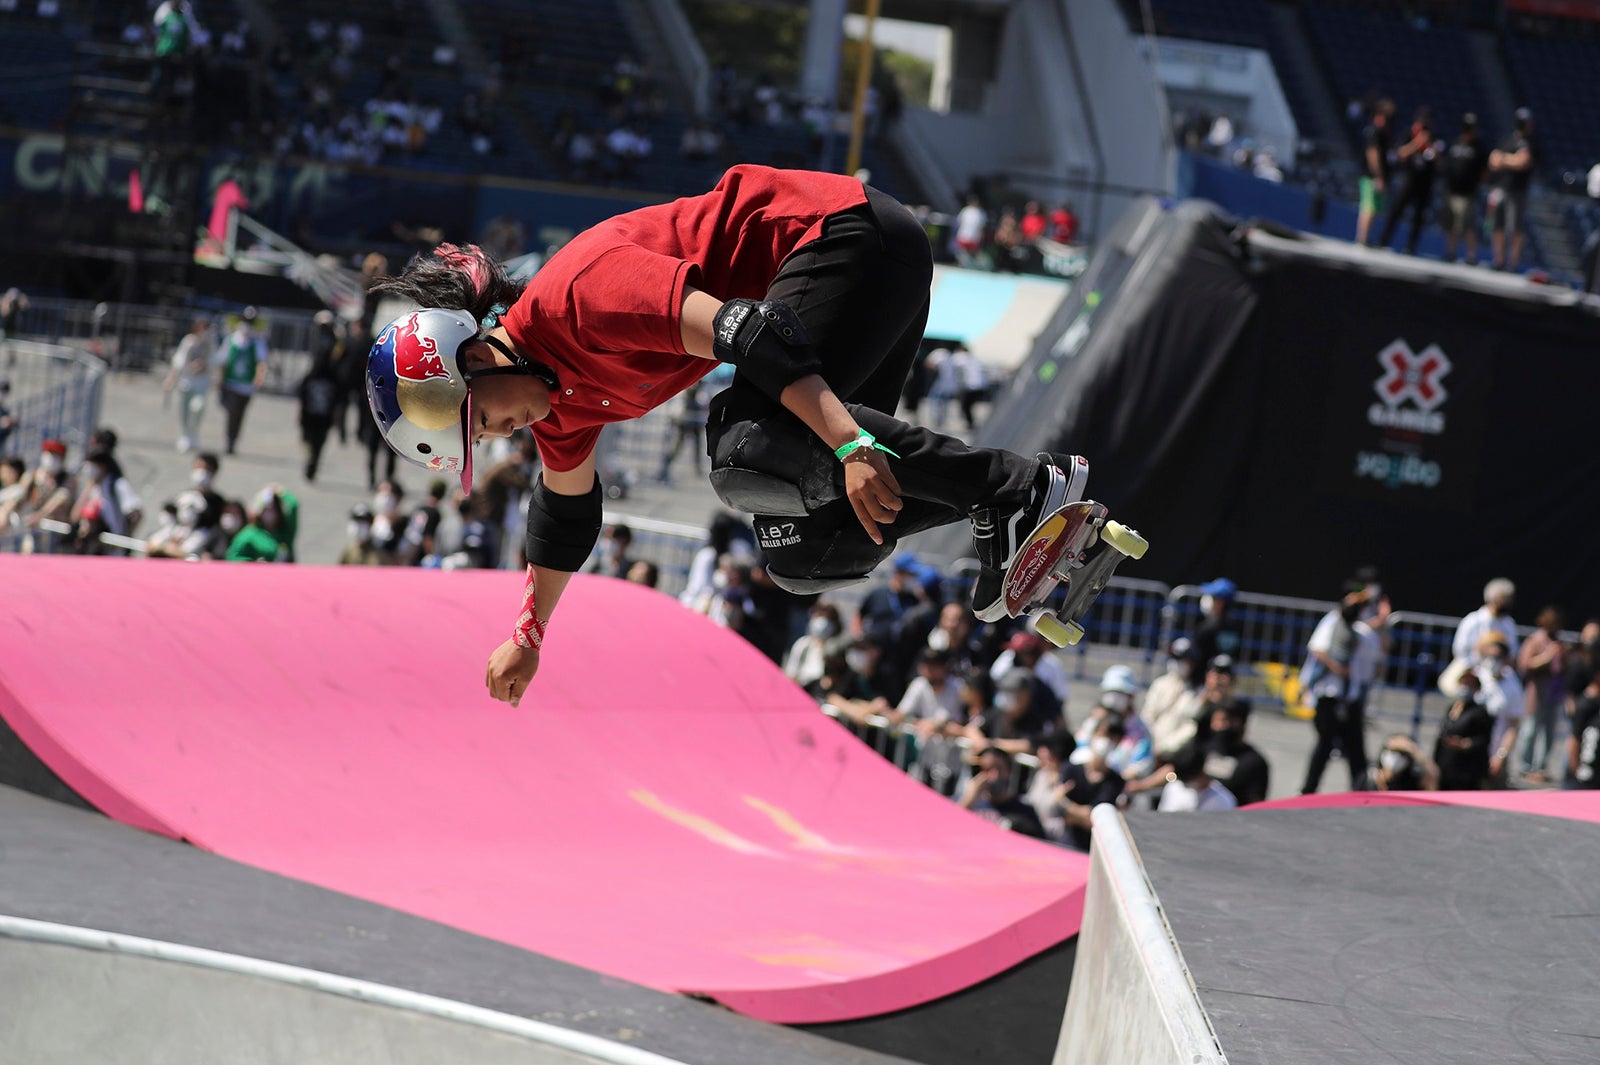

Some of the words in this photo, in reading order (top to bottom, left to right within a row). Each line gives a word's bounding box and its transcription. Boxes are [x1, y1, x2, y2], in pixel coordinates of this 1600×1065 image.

[719, 305, 742, 339] 187
[726, 321, 739, 345] KILLER
[735, 307, 749, 323] PADS
[760, 523, 795, 539] 187
[761, 539, 782, 548] KILLER
[781, 534, 802, 547] PADS
